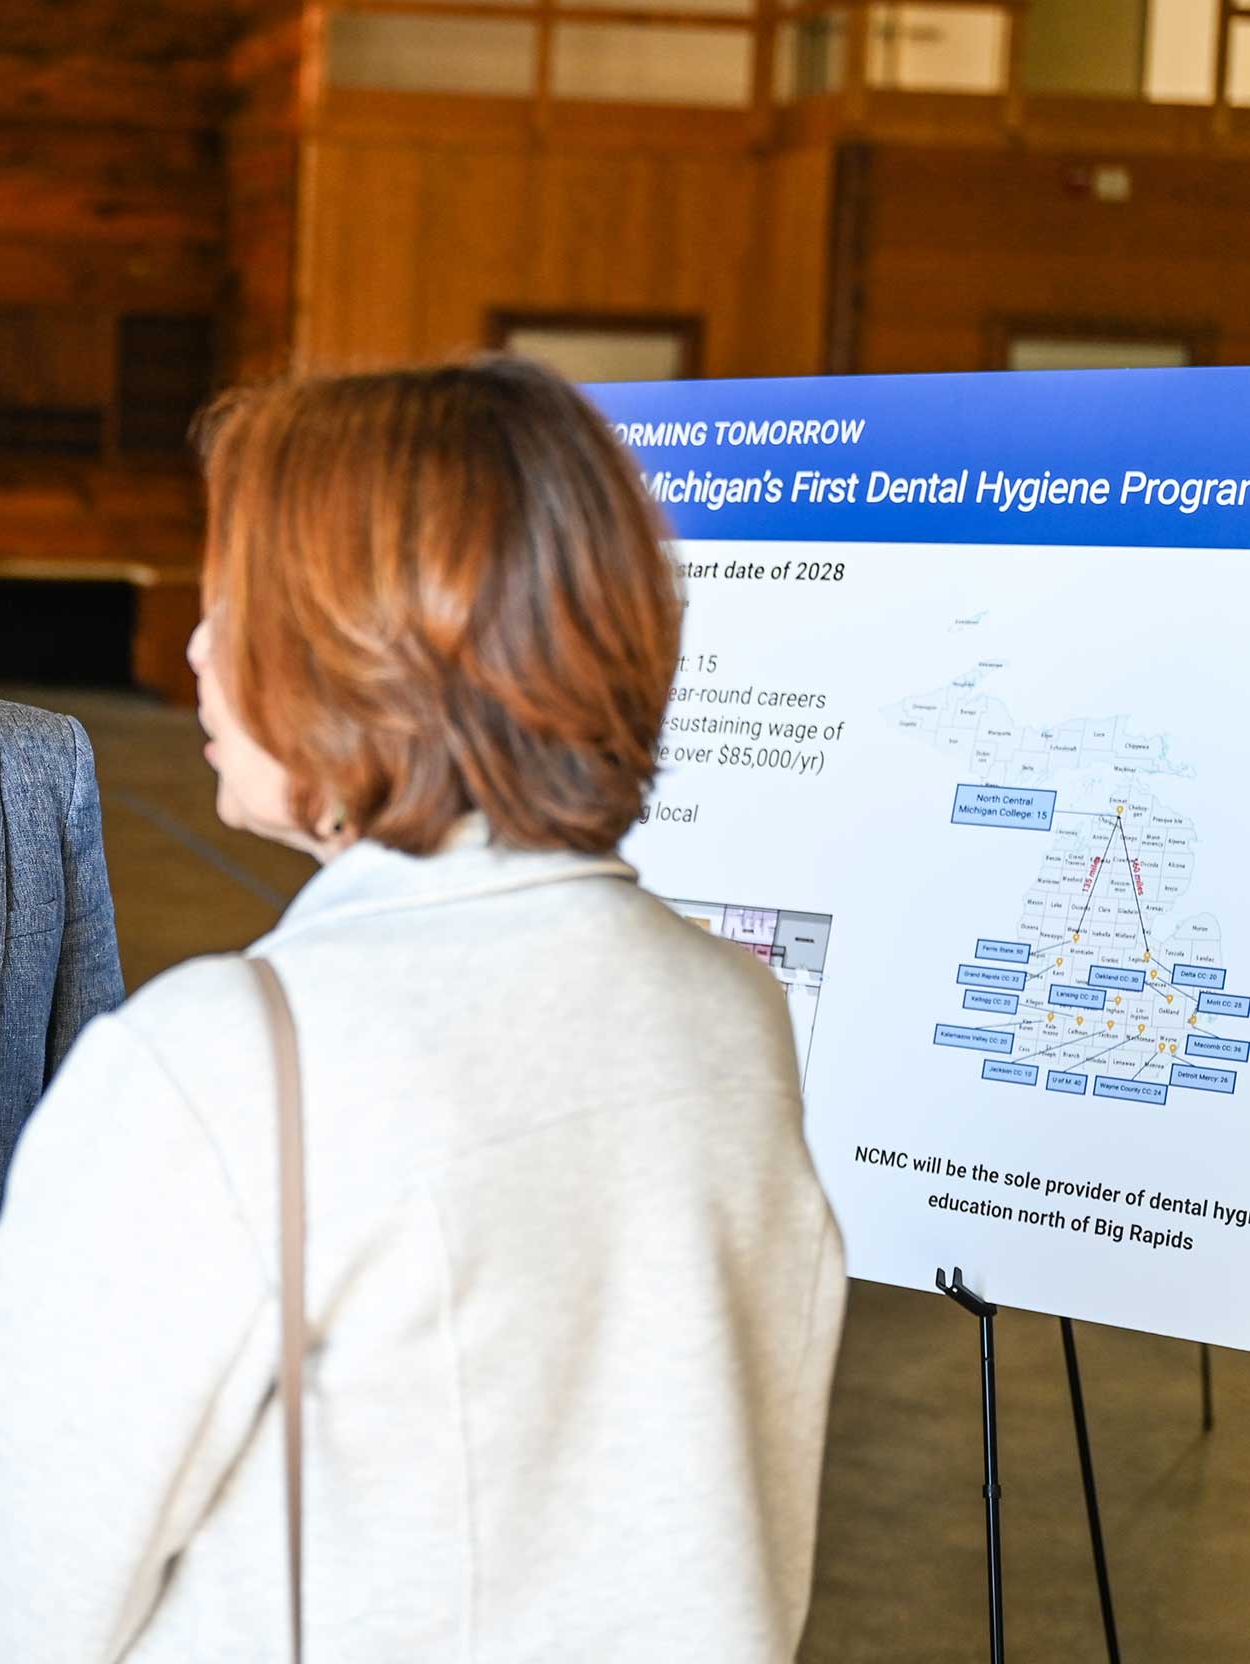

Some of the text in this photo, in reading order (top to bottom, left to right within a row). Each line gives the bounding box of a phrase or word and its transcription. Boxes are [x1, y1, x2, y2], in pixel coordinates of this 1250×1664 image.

[607, 419, 866, 447] ORMING TOMORROW
[791, 470, 859, 503] First
[866, 469, 969, 504] Dental
[975, 470, 1110, 512] Hygiene
[677, 560, 845, 581] start date of 2028
[697, 655, 718, 673] 15
[668, 686, 826, 709] ear-round careers
[768, 722, 818, 744] wage
[823, 721, 845, 740] of
[674, 746, 714, 763] over
[717, 744, 825, 775] $85,000/yr)
[976, 793, 1033, 806] North Central
[655, 801, 699, 823] local
[958, 805, 998, 816] Michigan
[1037, 811, 1048, 820] 15
[1095, 973, 1119, 981] Oakland
[1056, 991, 1079, 1000] Lansing
[1194, 1041, 1221, 1050] Macomb
[1222, 1044, 1232, 1052] CC:
[990, 1066, 1012, 1075] Jackson
[1178, 1071, 1198, 1080] Detroit
[1100, 1082, 1119, 1091] Wayne
[1120, 1085, 1141, 1095] County
[1142, 1088, 1152, 1096] CC:
[855, 1146, 908, 1168] NCMC
[913, 1157, 941, 1174] will
[946, 1160, 967, 1178] be
[972, 1164, 999, 1183] the
[1004, 1172, 1041, 1190] sole
[1045, 1179, 1121, 1202] provider
[1125, 1190, 1145, 1207] of
[1149, 1192, 1208, 1217] dental
[928, 1193, 1193, 1250] education north of Big Rapids
